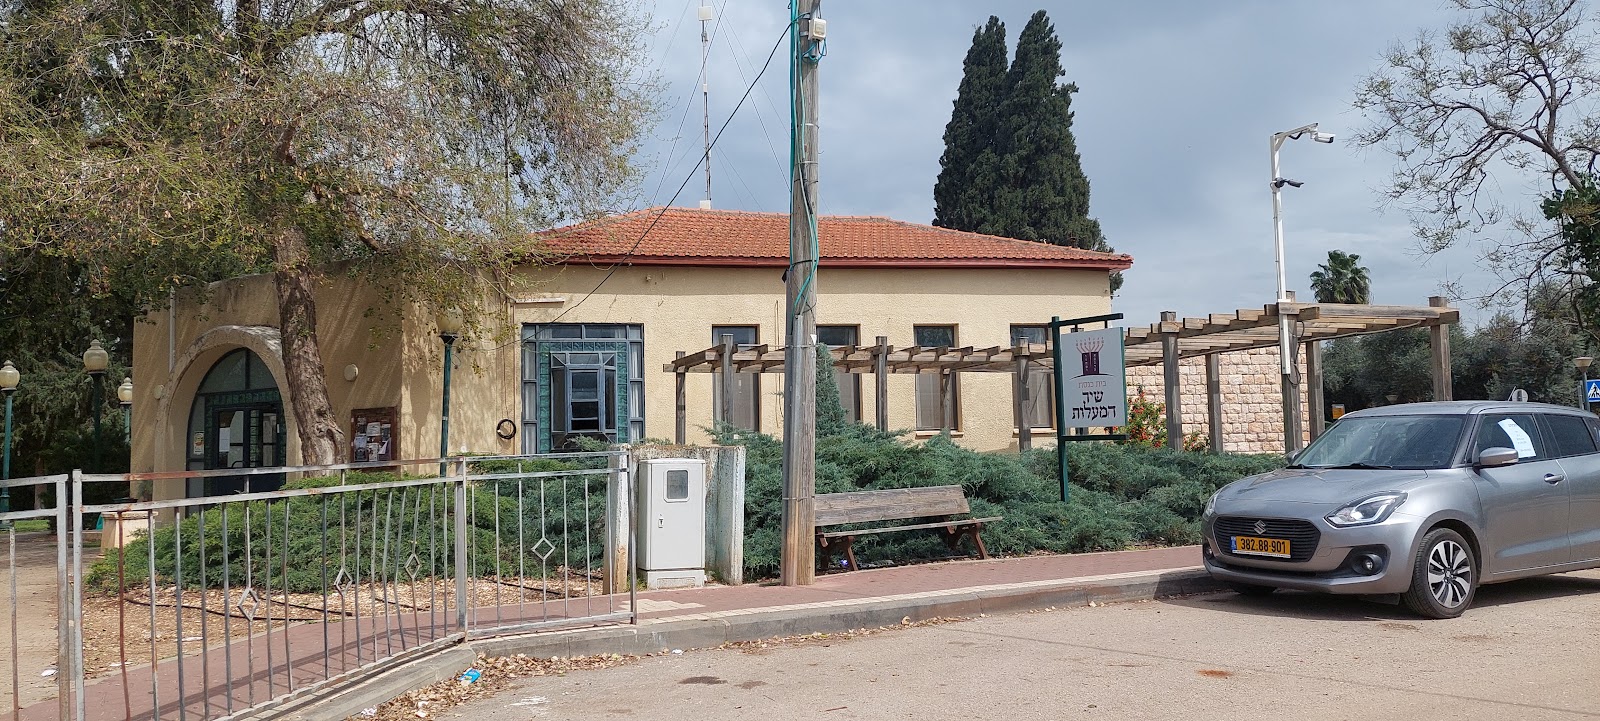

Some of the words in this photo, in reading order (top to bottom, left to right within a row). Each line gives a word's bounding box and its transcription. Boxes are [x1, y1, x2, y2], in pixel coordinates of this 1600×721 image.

[1078, 381, 1094, 389] כנסת
[1096, 380, 1107, 388] בית
[1082, 390, 1104, 403] שיר
[1071, 401, 1116, 420] המעלות
